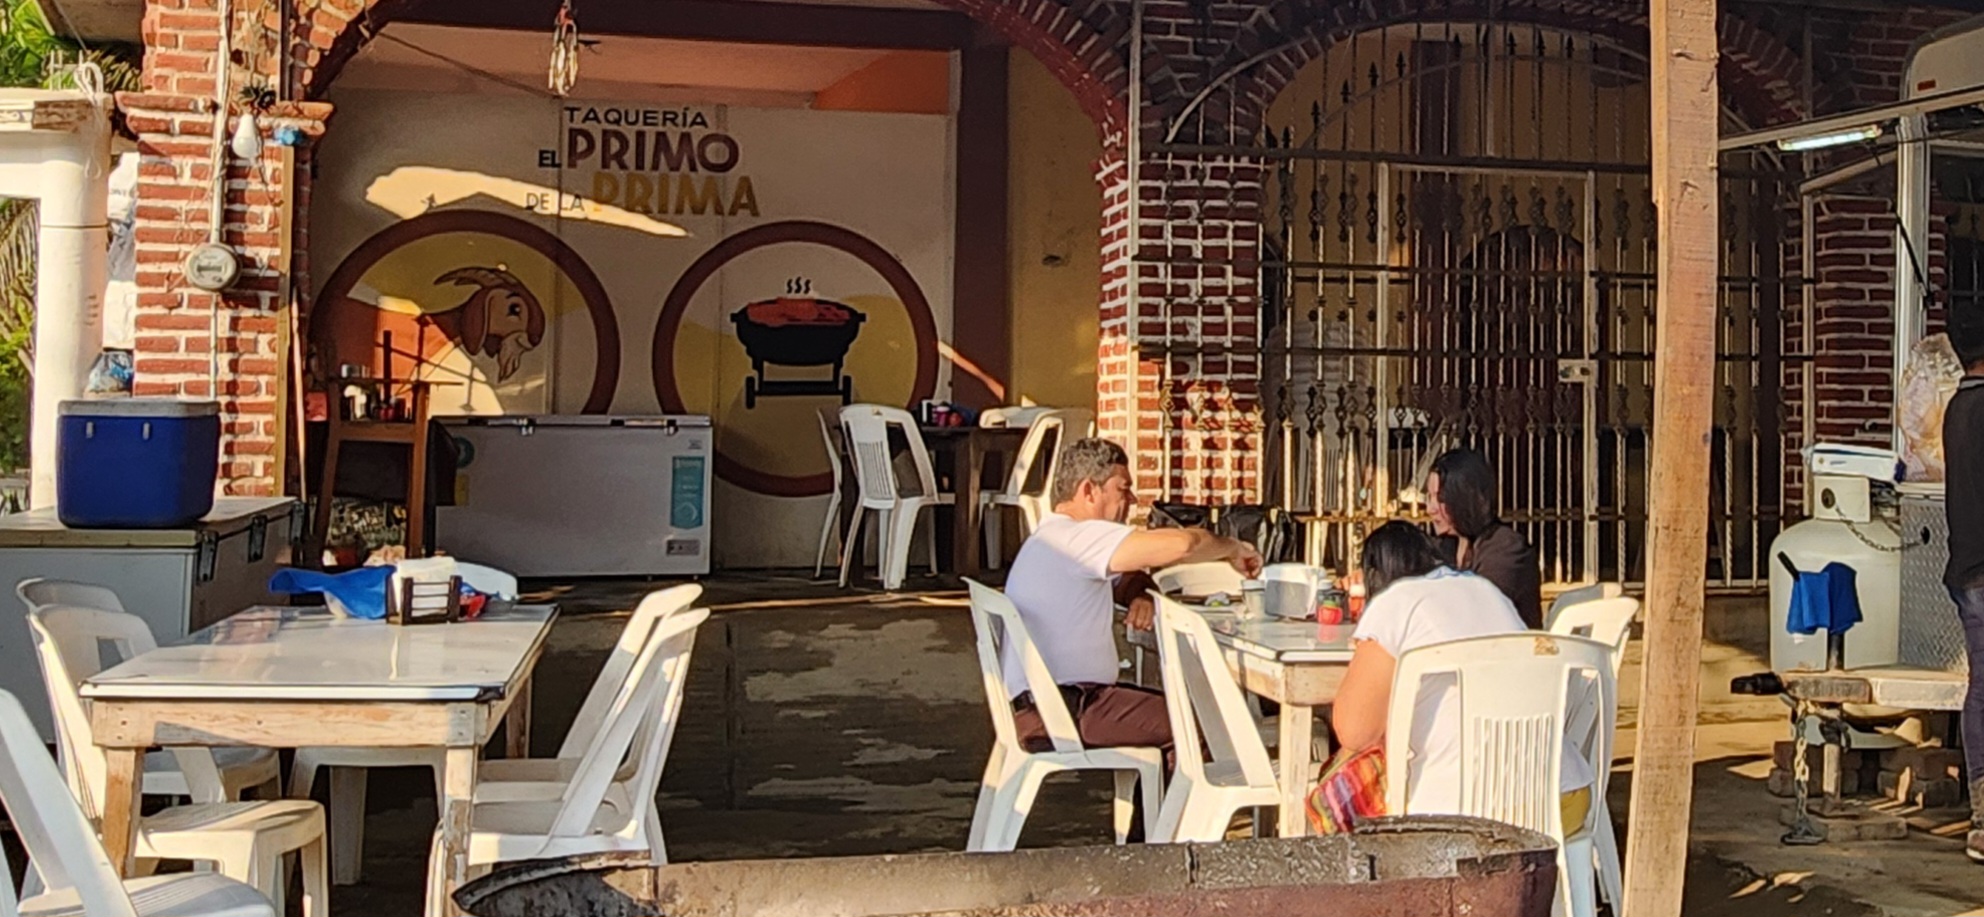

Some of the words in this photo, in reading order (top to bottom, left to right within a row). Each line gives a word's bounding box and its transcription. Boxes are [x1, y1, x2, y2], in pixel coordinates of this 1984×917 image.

[564, 106, 708, 128] TAQUERÍA
[538, 149, 561, 168] EL
[567, 128, 739, 173] PRIMO
[526, 192, 550, 210] DE
[560, 193, 585, 212] LA
[592, 172, 760, 216] PRIMA
